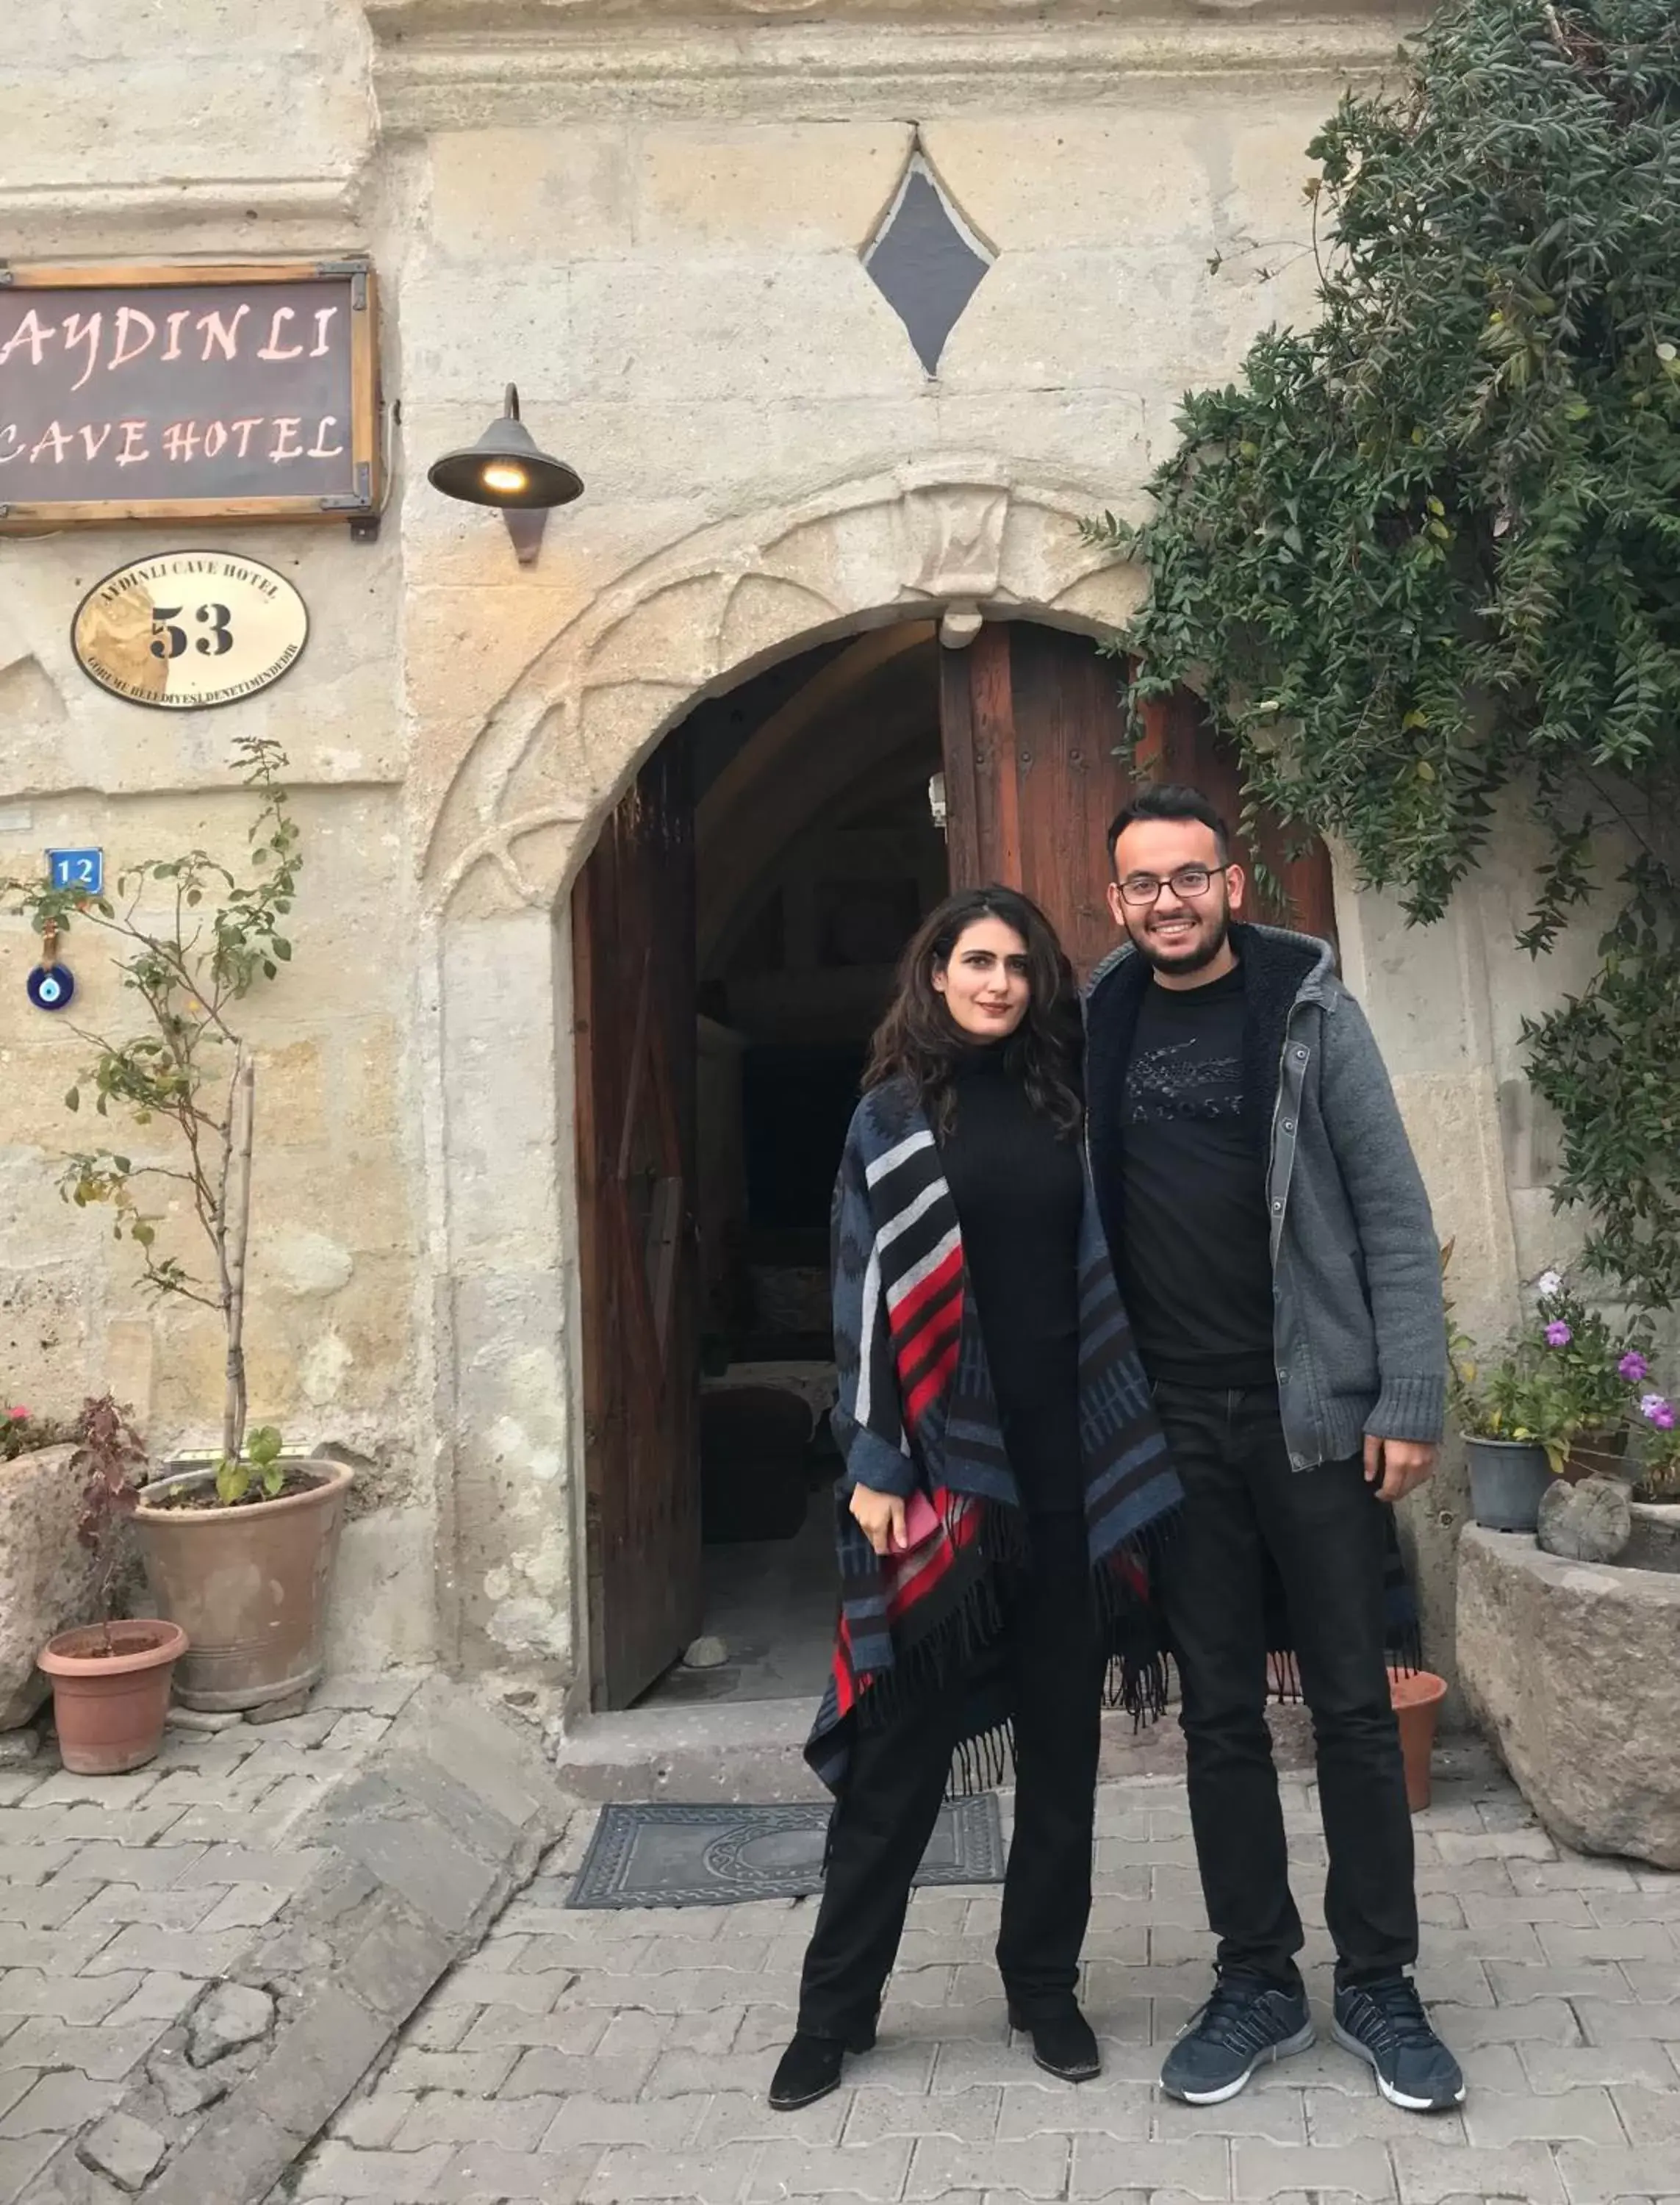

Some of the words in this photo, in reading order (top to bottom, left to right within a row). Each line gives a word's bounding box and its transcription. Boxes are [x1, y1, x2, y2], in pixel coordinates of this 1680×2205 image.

[0, 304, 338, 391] AYDINLI
[0, 420, 150, 467] CAVE
[162, 415, 343, 463] HOTEL
[101, 564, 167, 606] AYDINLI
[172, 560, 218, 575] CAVE
[223, 564, 279, 600] HOTEL
[150, 603, 234, 659] 53
[57, 858, 93, 883] 12
